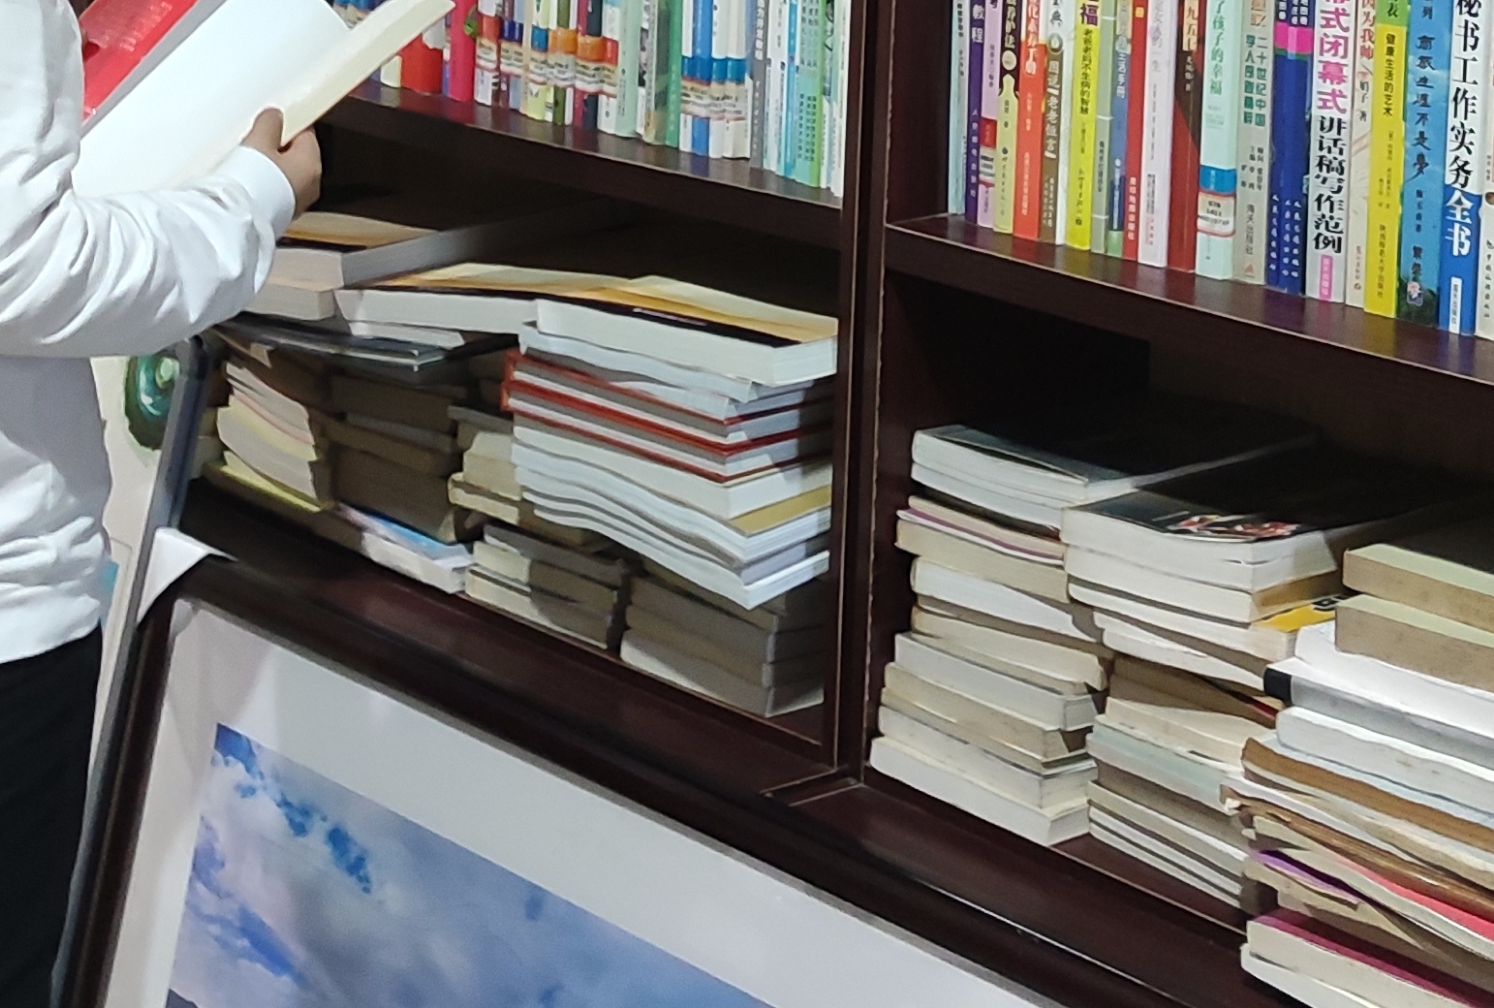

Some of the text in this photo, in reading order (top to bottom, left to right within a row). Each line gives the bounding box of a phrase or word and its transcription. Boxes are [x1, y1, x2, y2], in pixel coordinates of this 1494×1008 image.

[1253, 35, 1267, 127] 二十世纪中国
[1381, 32, 1398, 118] 健康生活的艺术
[1312, 116, 1347, 255] 讲话稿写作范例
